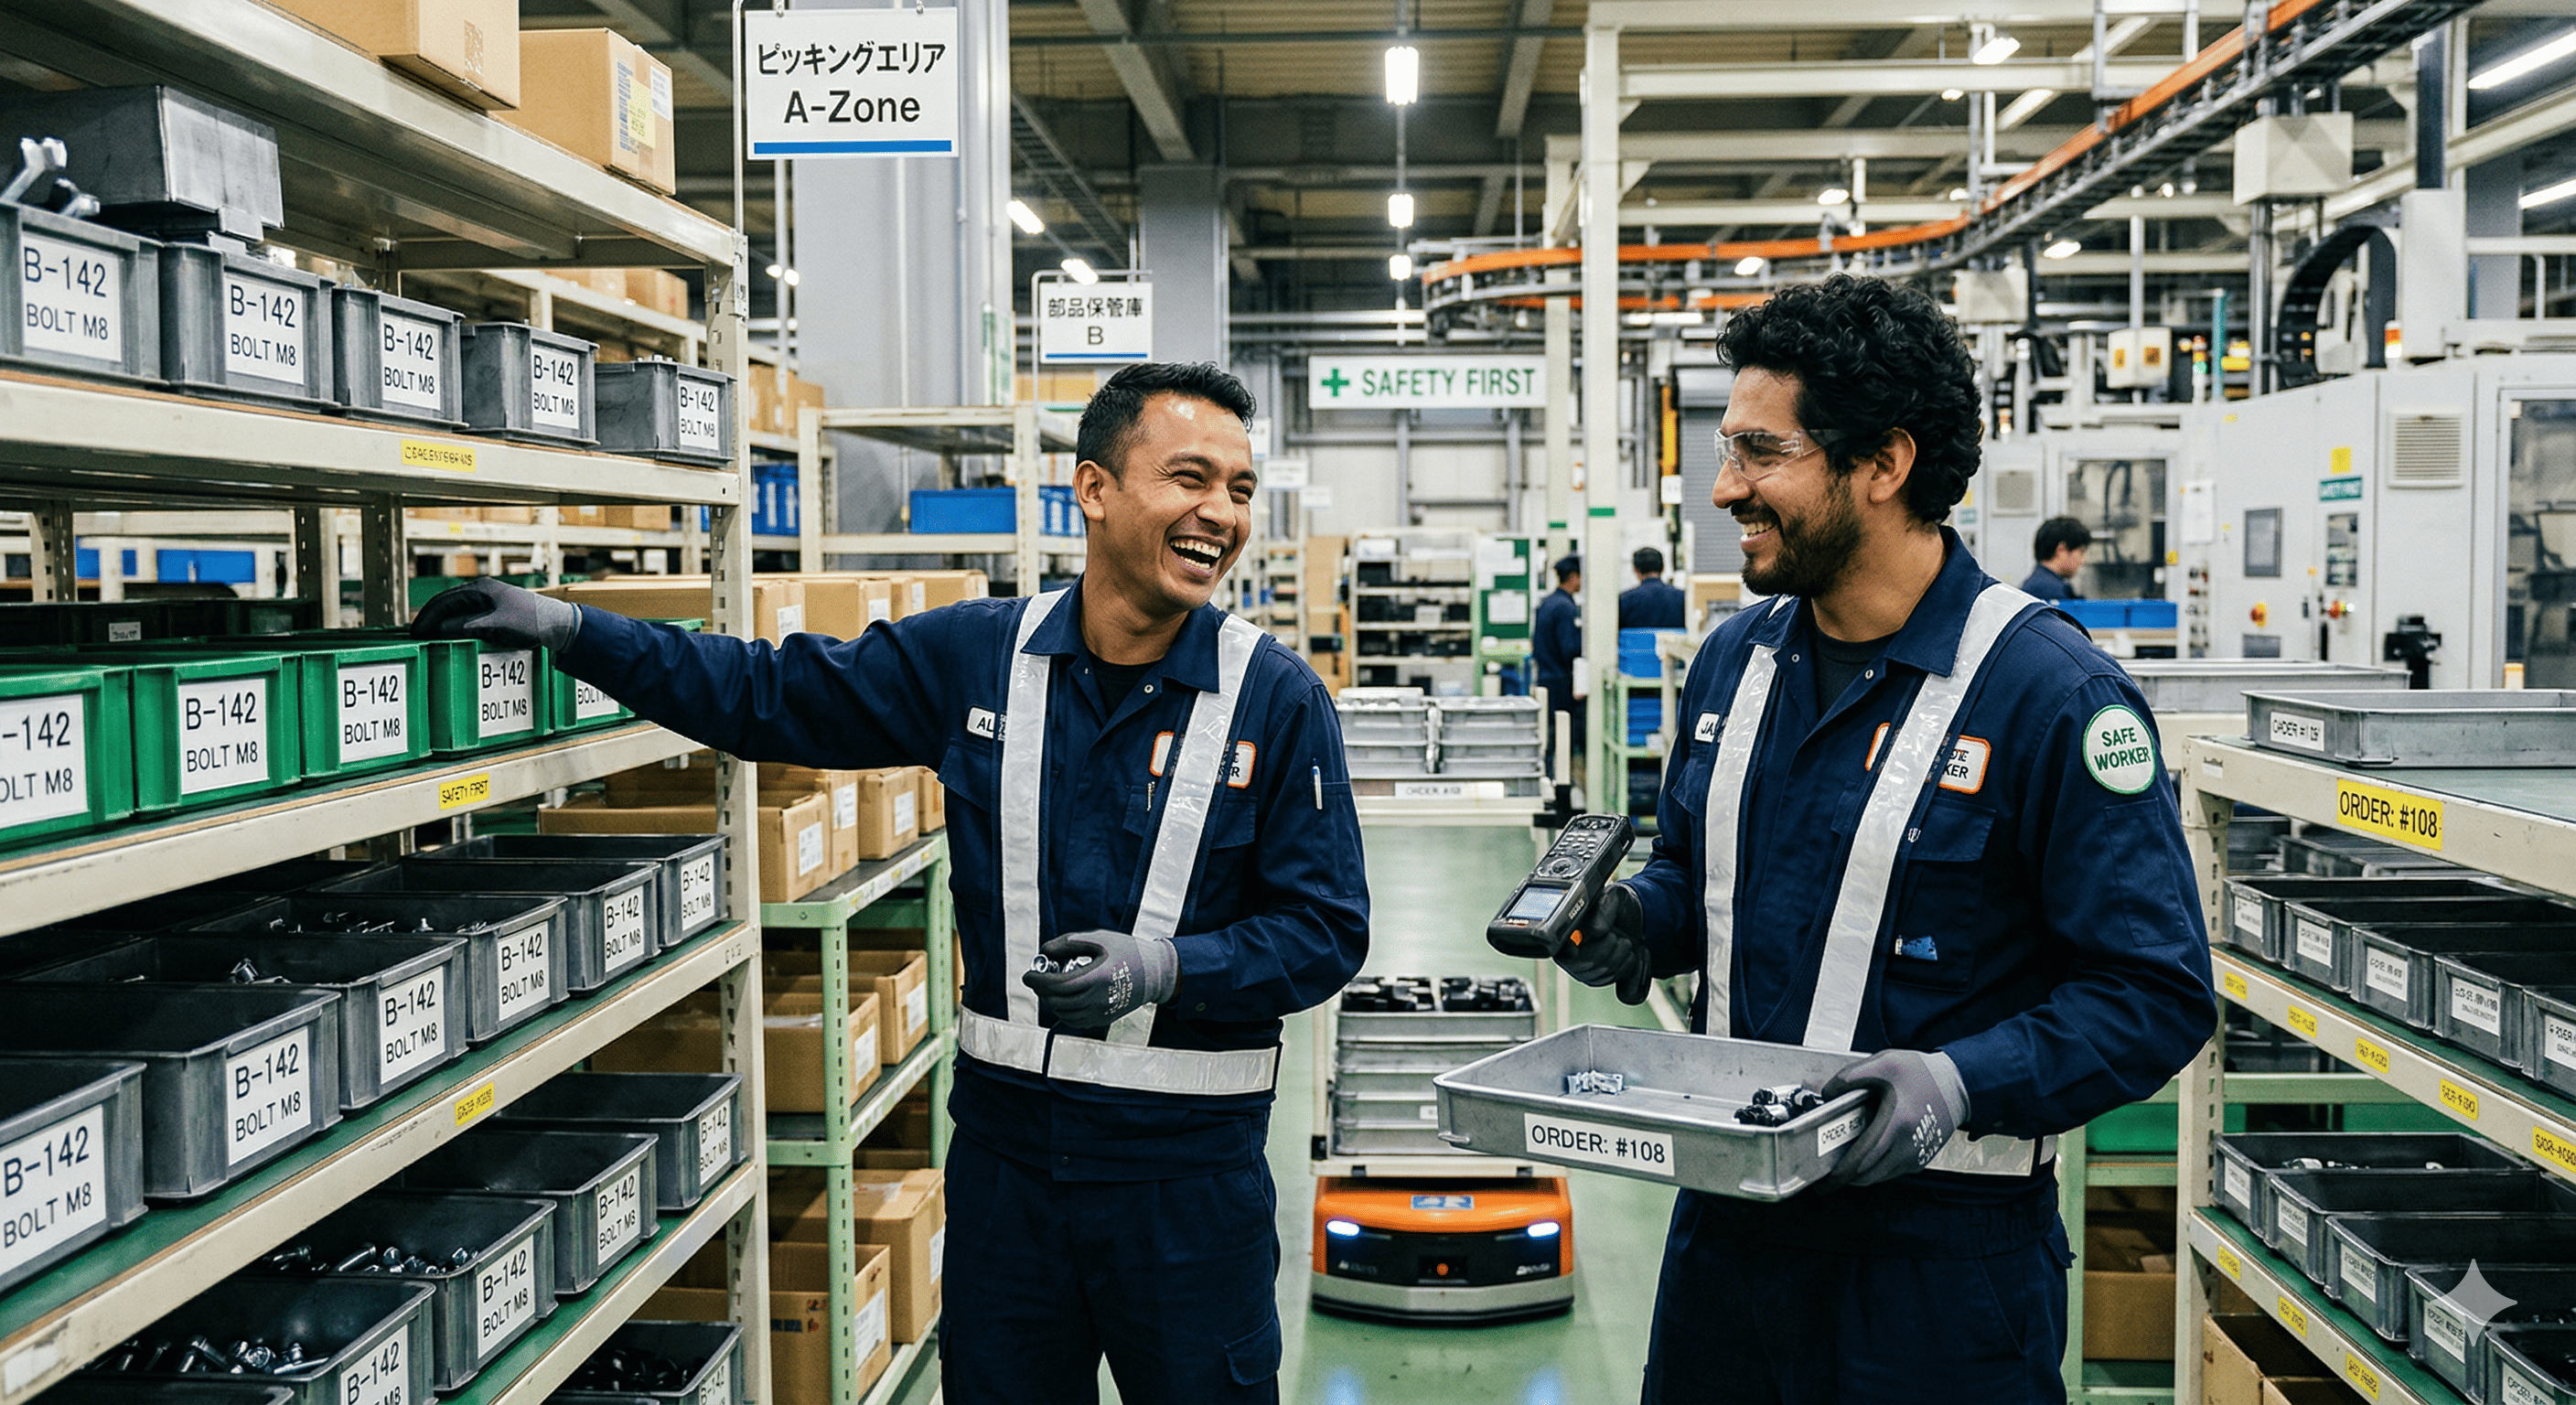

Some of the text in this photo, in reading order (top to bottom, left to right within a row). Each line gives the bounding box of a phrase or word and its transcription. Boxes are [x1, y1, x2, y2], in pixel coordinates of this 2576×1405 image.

[757, 41, 946, 76] ピッキングエリア
[784, 90, 920, 124] A-Zone
[25, 246, 107, 298] B-142
[27, 303, 108, 340] BOLT M8
[231, 284, 295, 328] B-142
[1048, 297, 1143, 317] 部品保管庫
[231, 333, 296, 366] BOLT M8
[384, 323, 434, 361] B-142
[1088, 326, 1103, 345] B
[384, 367, 435, 395] BOLT M8
[534, 354, 574, 386] B-142
[1362, 369, 1536, 395] SAFETY FIRST
[534, 391, 574, 416] BOLT M8
[681, 385, 714, 413] B-142
[344, 674, 399, 709] B-142
[481, 659, 526, 690] B-142
[186, 692, 256, 730] B-142
[482, 702, 510, 722] BOLT
[3, 712, 70, 750] -142
[345, 717, 401, 745] BOLT M8
[2101, 726, 2137, 747] SAFE
[187, 741, 258, 773] BOLT M8
[2094, 746, 2151, 771] WORKER
[0, 767, 73, 803] OLT M8
[2340, 790, 2437, 839] ORDER: #108
[682, 861, 711, 892] B-142
[606, 894, 639, 929] B-142
[502, 931, 542, 972] B-142
[606, 928, 641, 960] BOLT M8
[385, 980, 435, 1027] B-142
[502, 969, 544, 1004] BOLT M8
[386, 1022, 437, 1064] BOLT M8
[235, 1043, 299, 1099] B-142
[236, 1091, 301, 1142] BOLT M8
[3, 1125, 90, 1198] B-142
[1531, 1124, 1666, 1164] ORDER: #108
[600, 1174, 635, 1220] B-142
[4, 1182, 91, 1249] BOLT M8
[599, 1221, 622, 1250] BOLT
[483, 1249, 527, 1303] B-142
[483, 1287, 529, 1338] BOLT M8
[348, 1341, 399, 1405] B-142
